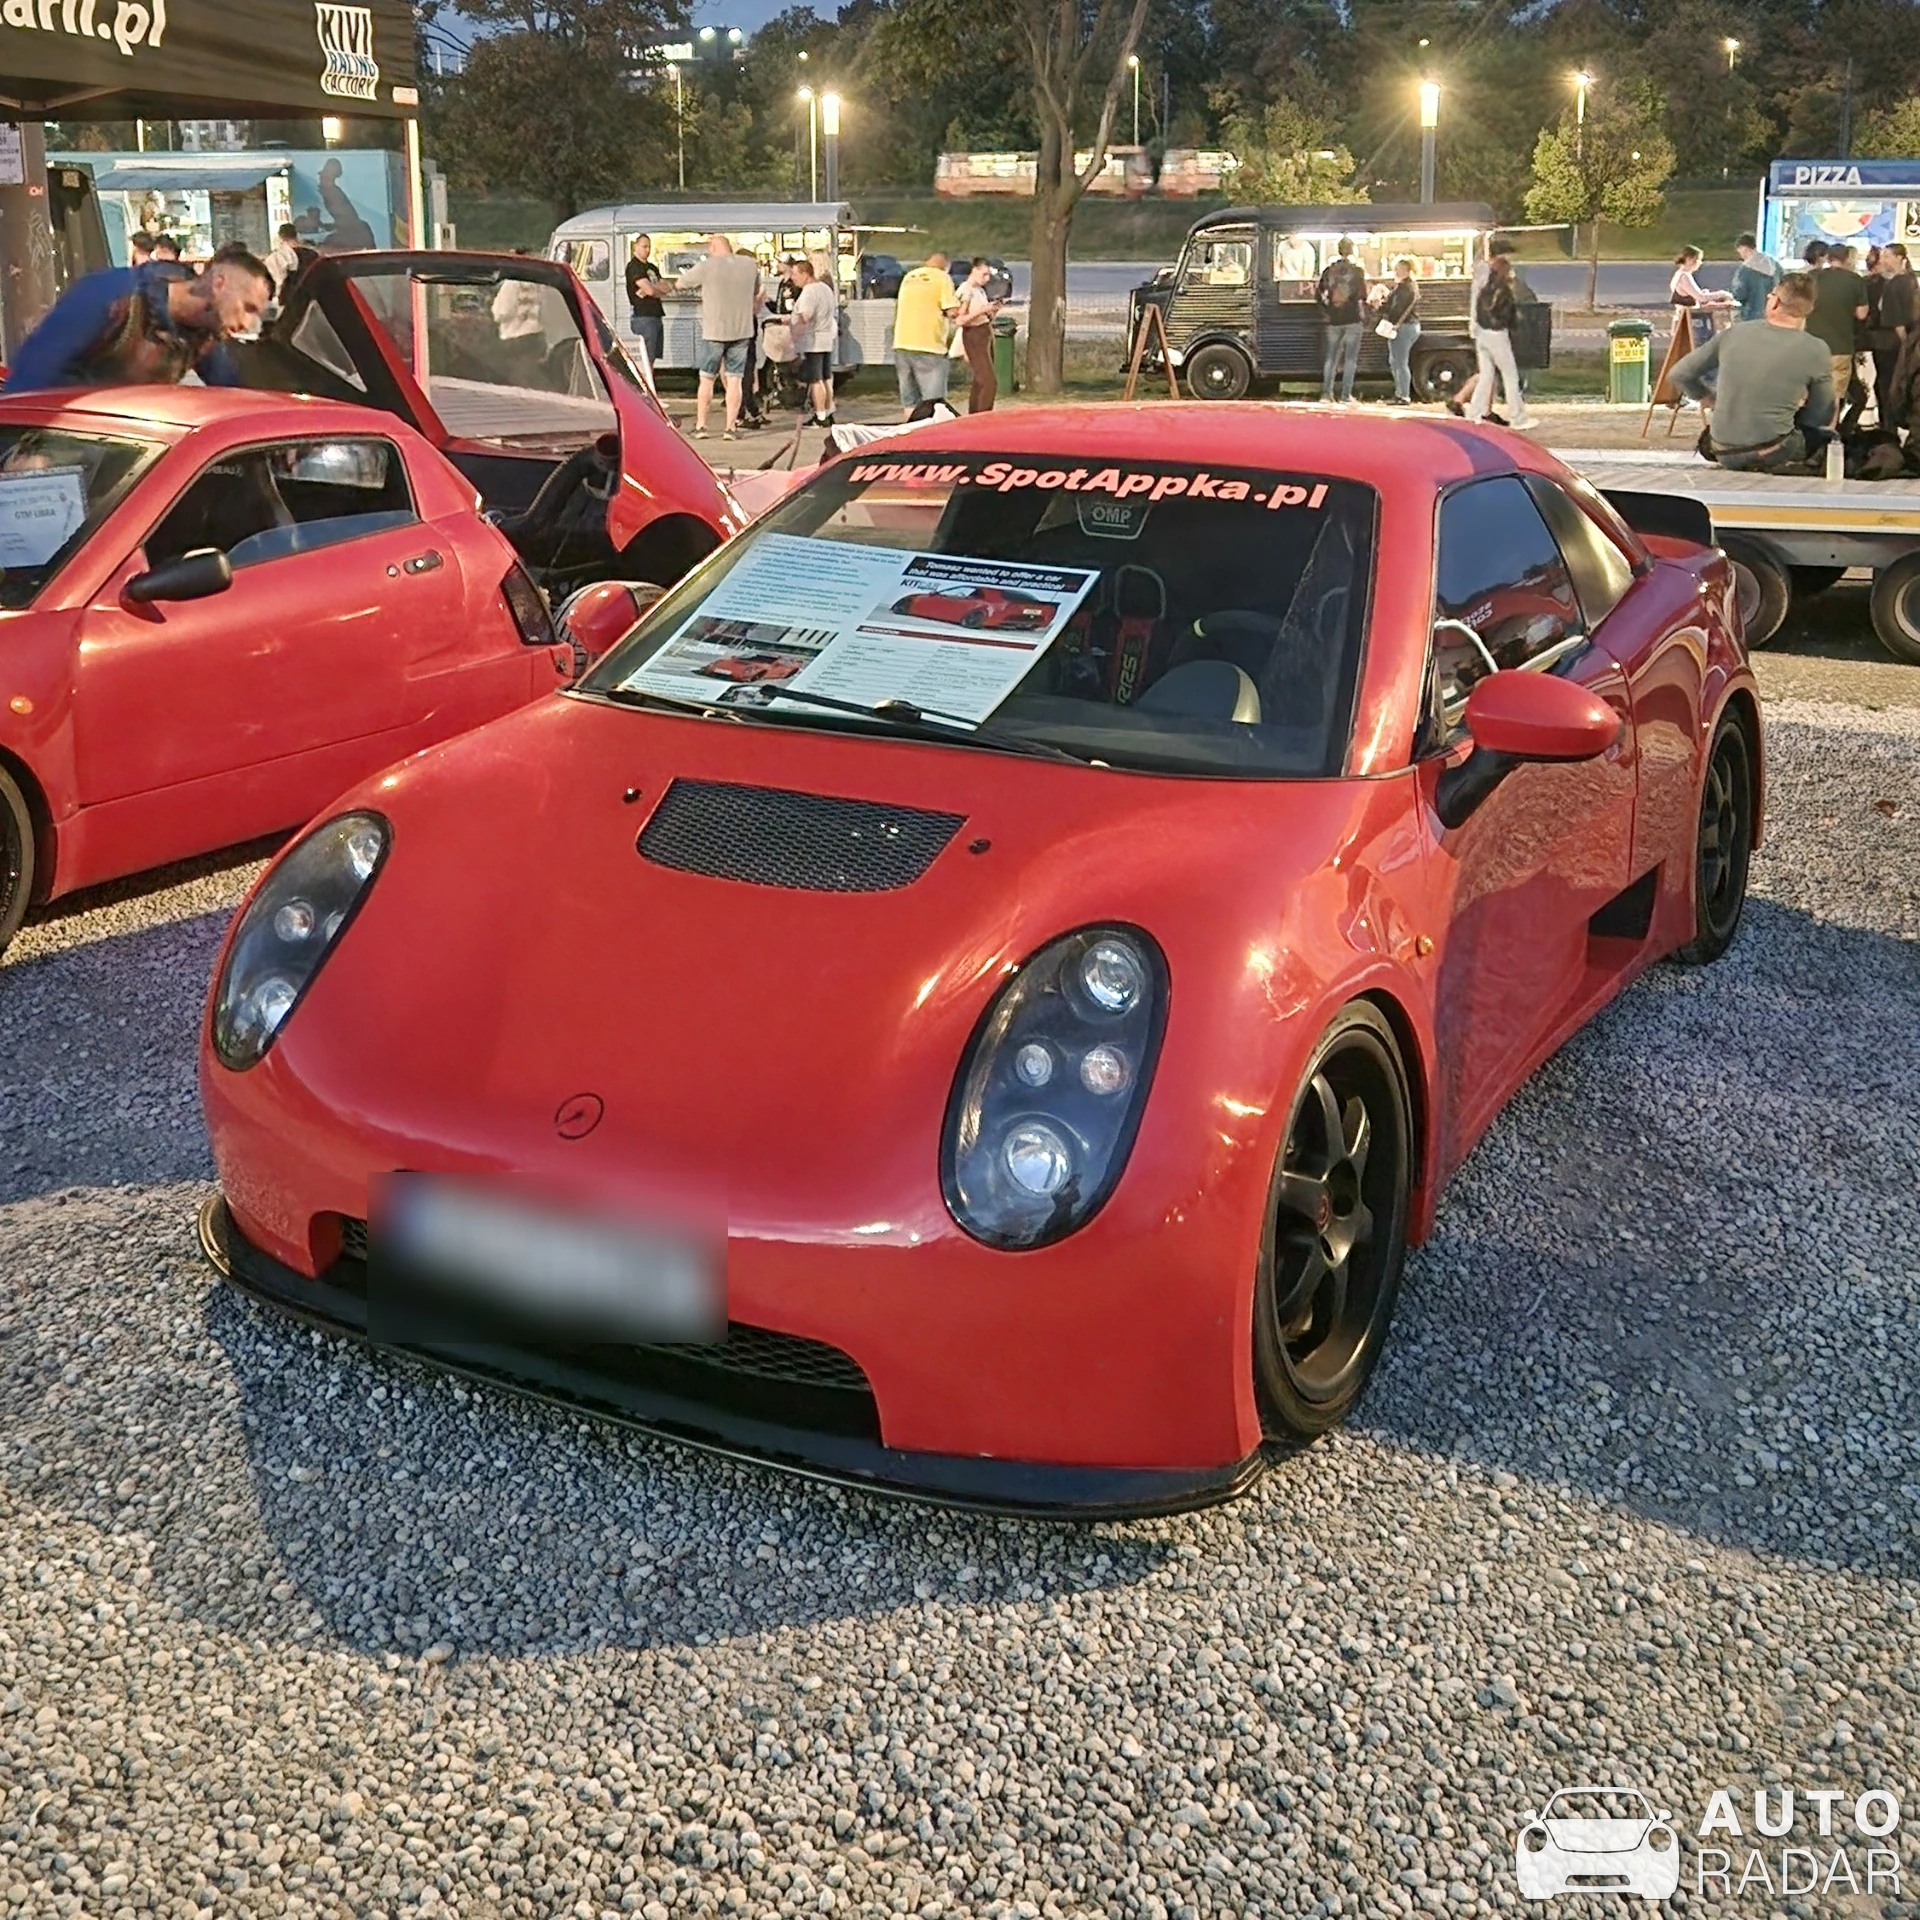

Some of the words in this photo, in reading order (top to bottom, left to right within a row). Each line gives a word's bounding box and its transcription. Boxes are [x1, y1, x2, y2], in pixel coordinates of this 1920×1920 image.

[320, 8, 369, 55] KIVI
[327, 51, 376, 77] RACING
[324, 74, 375, 97] FACTORY
[1795, 166, 1862, 185] PIZZA
[848, 462, 1330, 510] www.SpotAppka.pl
[1092, 505, 1132, 523] OMP
